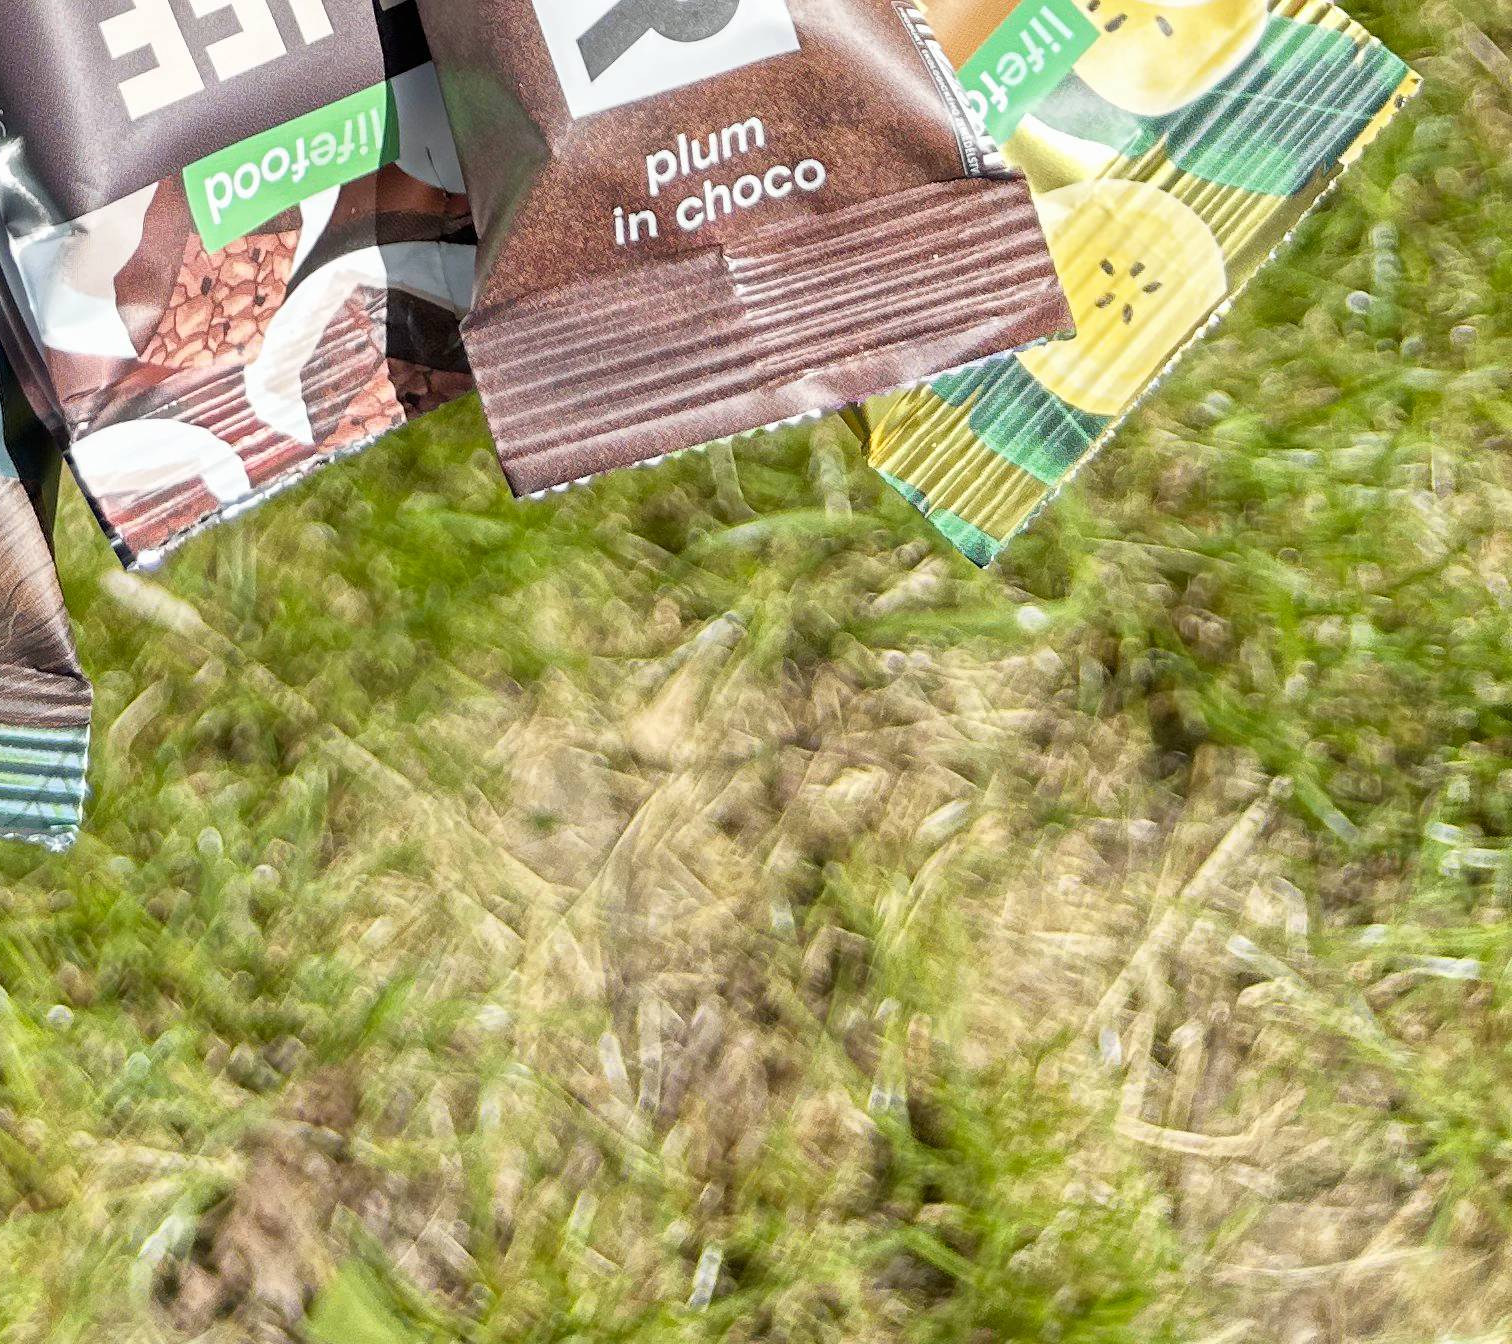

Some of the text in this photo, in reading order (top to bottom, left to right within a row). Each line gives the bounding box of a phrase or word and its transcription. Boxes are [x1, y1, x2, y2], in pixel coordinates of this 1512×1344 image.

[962, 4, 1074, 138] lifefo
[203, 107, 384, 225] lifefood
[612, 158, 827, 246] in choco
[645, 115, 766, 197] plum
